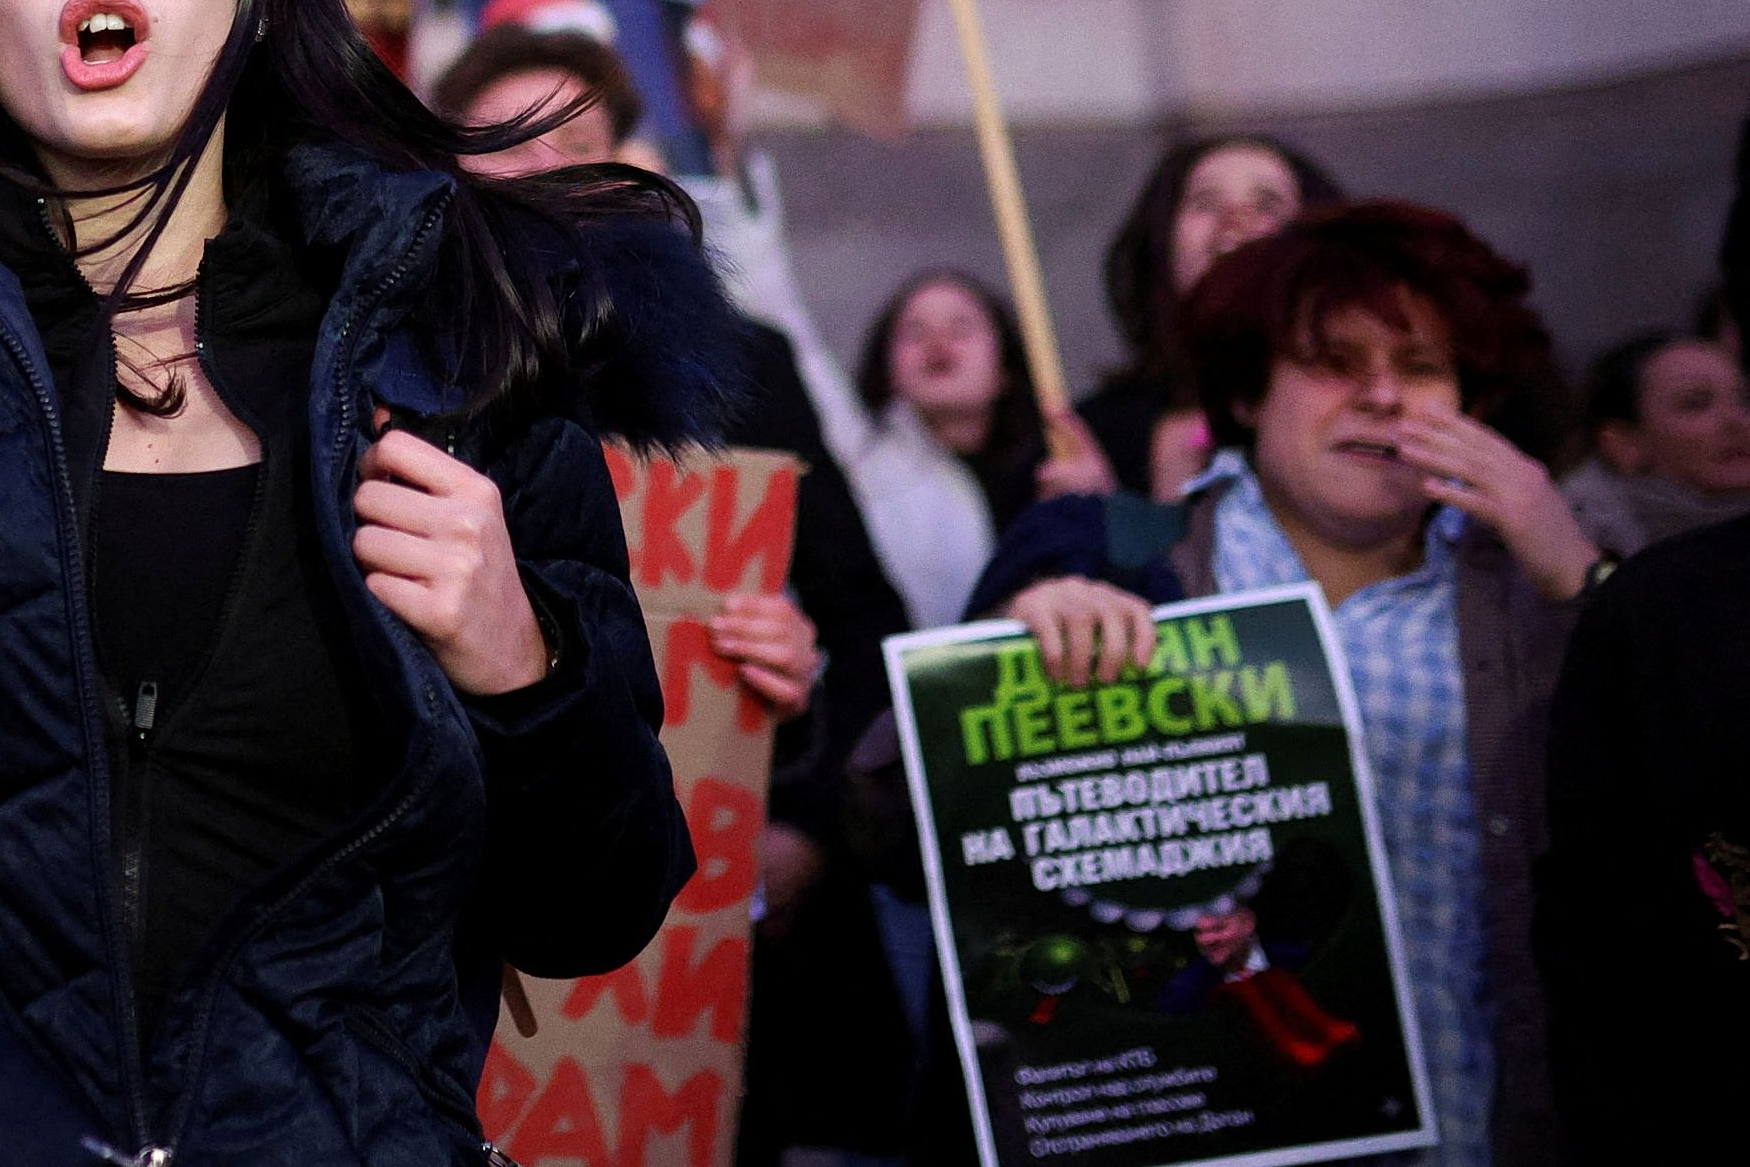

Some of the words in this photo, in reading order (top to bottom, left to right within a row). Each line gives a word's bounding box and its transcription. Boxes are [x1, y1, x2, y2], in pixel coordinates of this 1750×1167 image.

[960, 662, 1296, 766] ПЕЕВСКИ
[961, 827, 1016, 865] НА
[1021, 781, 1333, 857] ГАЛАКТИЧЕСКИЯ
[1008, 753, 1270, 822] ПЪТЕВОДИТЕЛ
[1030, 828, 1273, 891] СХЕМАДЖИЯ
